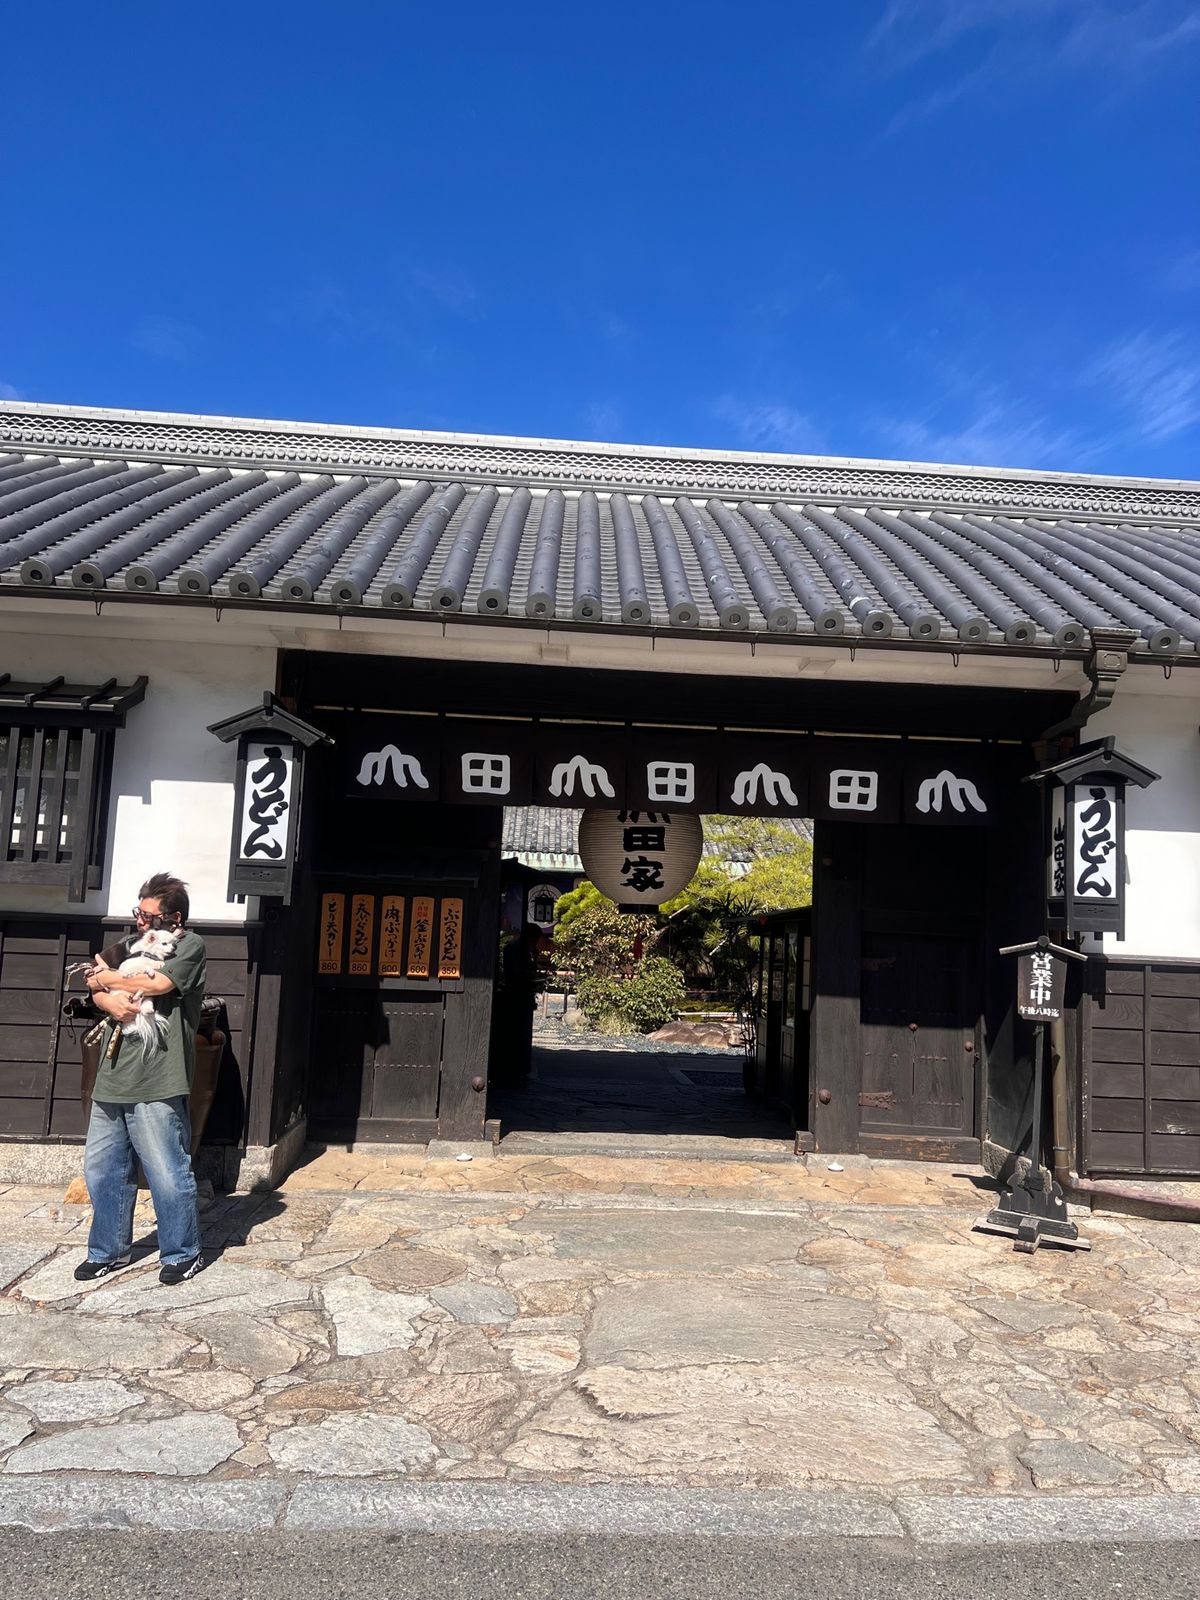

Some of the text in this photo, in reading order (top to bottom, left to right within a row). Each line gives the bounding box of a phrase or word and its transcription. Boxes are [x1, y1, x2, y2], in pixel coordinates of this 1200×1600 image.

[243, 746, 289, 859] うどん
[1076, 787, 1117, 897] うどん
[321, 962, 338, 971] 860
[351, 963, 368, 972] 860
[381, 964, 398, 973] 800
[410, 965, 427, 974] 600
[441, 966, 457, 975] 350
[1030, 951, 1054, 1005] 営業中
